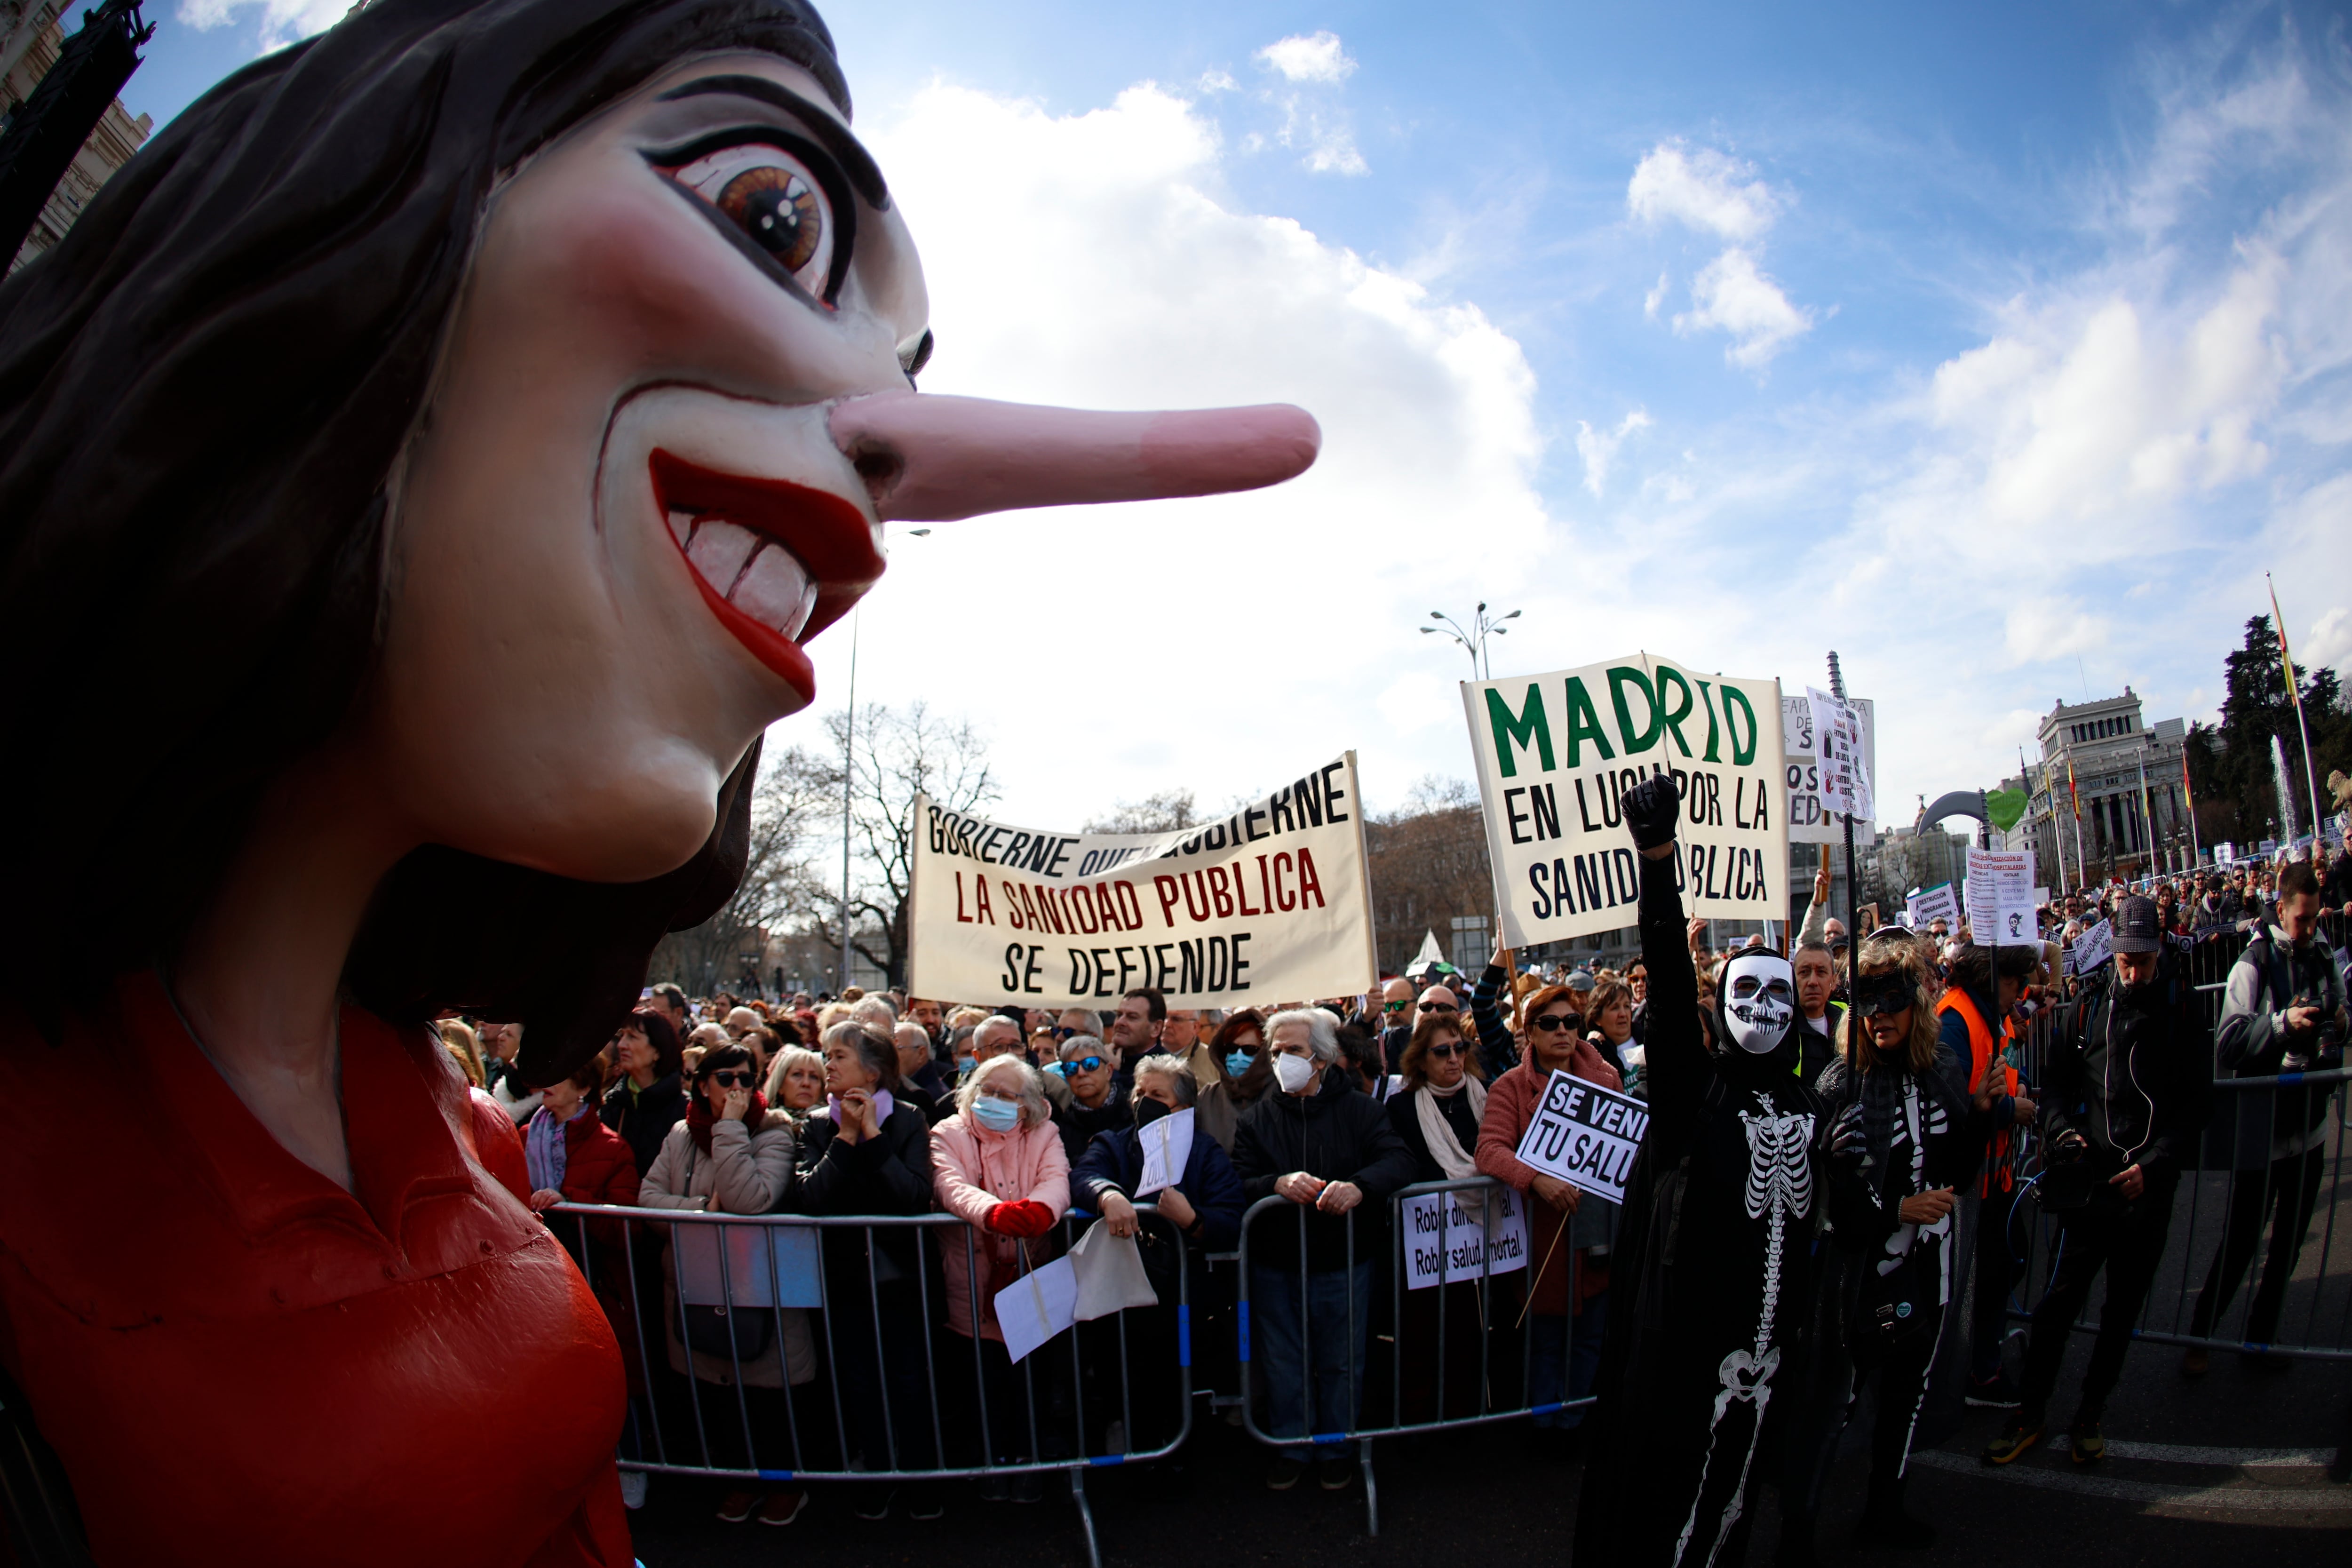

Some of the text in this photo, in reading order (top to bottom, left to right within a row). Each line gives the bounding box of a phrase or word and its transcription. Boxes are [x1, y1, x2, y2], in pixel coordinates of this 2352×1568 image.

[1484, 665, 1757, 778] MADRID
[1504, 783, 1561, 845] EN
[1672, 768, 1723, 826] POR
[1735, 777, 1768, 831] LA
[928, 805, 1080, 878] GOBIERNE
[956, 847, 1326, 934] LA SANIDAD PUBLICA
[1529, 839, 1767, 920] SANID BLICA
[1919, 891, 1946, 906] DESTRUCCIÓN
[1922, 900, 1949, 915] PROGRAMADA
[1002, 933, 1251, 996] SE DEFIENDE
[2077, 921, 2109, 968] SANIDAD-NEGOCIO
[1549, 1082, 1649, 1142] SE VEN
[1532, 1118, 1630, 1188] TU SALU
[1415, 1204, 1449, 1234] Robr
[1415, 1247, 1449, 1276] Robr
